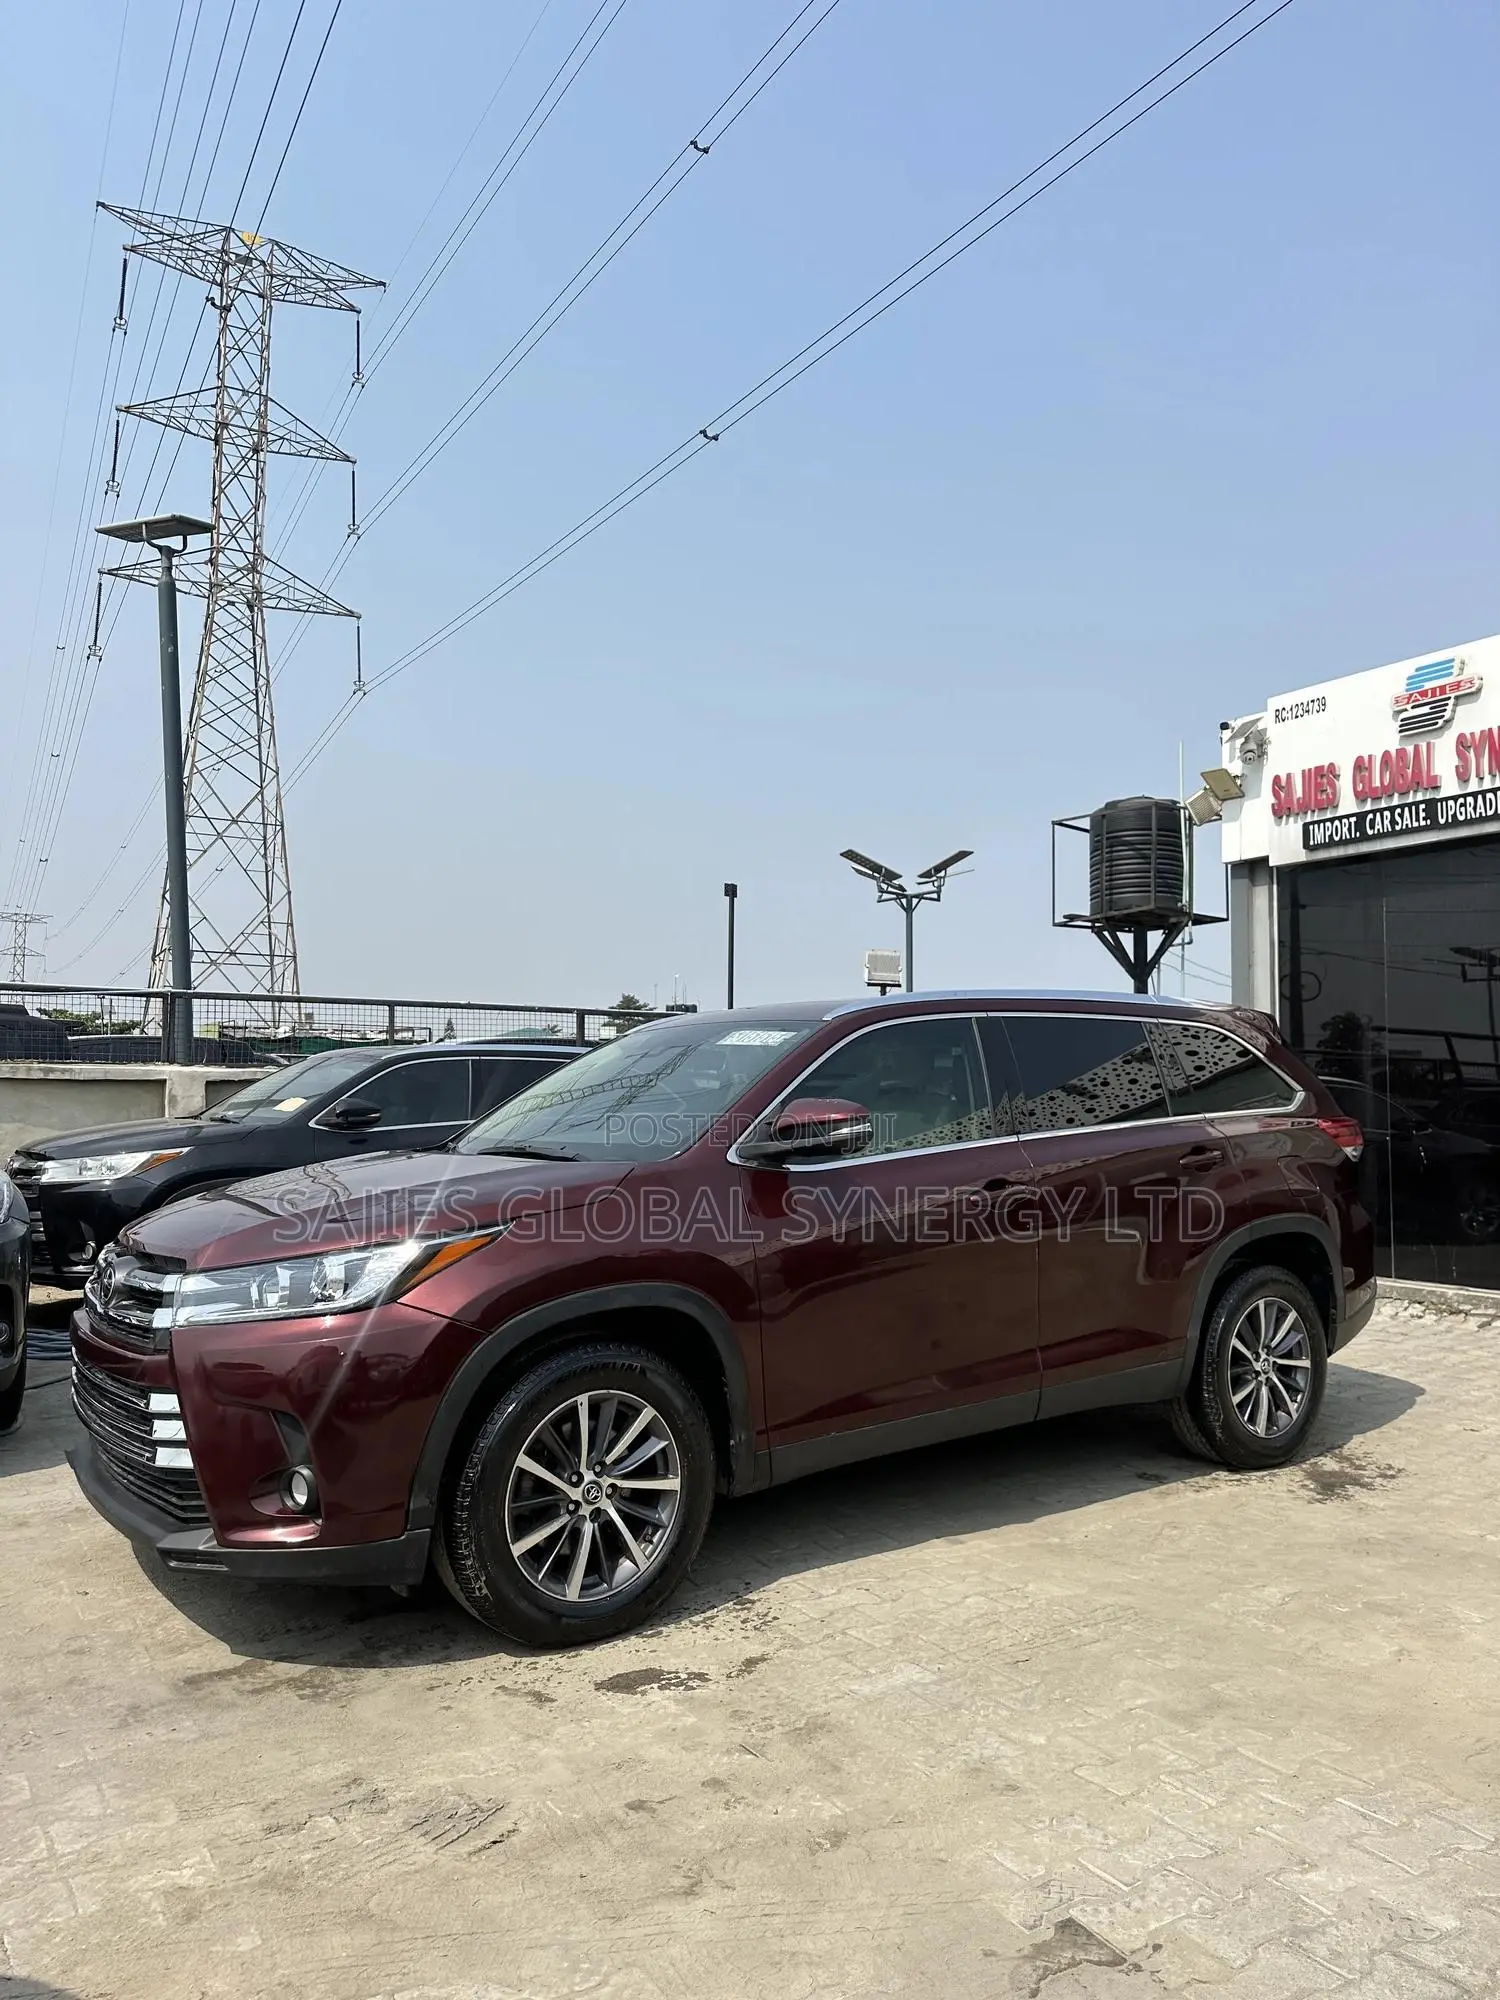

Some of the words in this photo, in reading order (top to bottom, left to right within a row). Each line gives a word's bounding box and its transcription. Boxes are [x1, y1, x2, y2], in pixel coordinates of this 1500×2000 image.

[1274, 697, 1326, 724] RC:1234739
[1393, 676, 1476, 708] SAJIES
[1271, 762, 1340, 819] SAJIES
[1352, 741, 1441, 801] GLOBAL
[1308, 816, 1360, 846] IMPORT.
[1366, 806, 1392, 835] CAR
[1394, 803, 1431, 829] SALE.
[1437, 790, 1500, 824] UPGRAD
